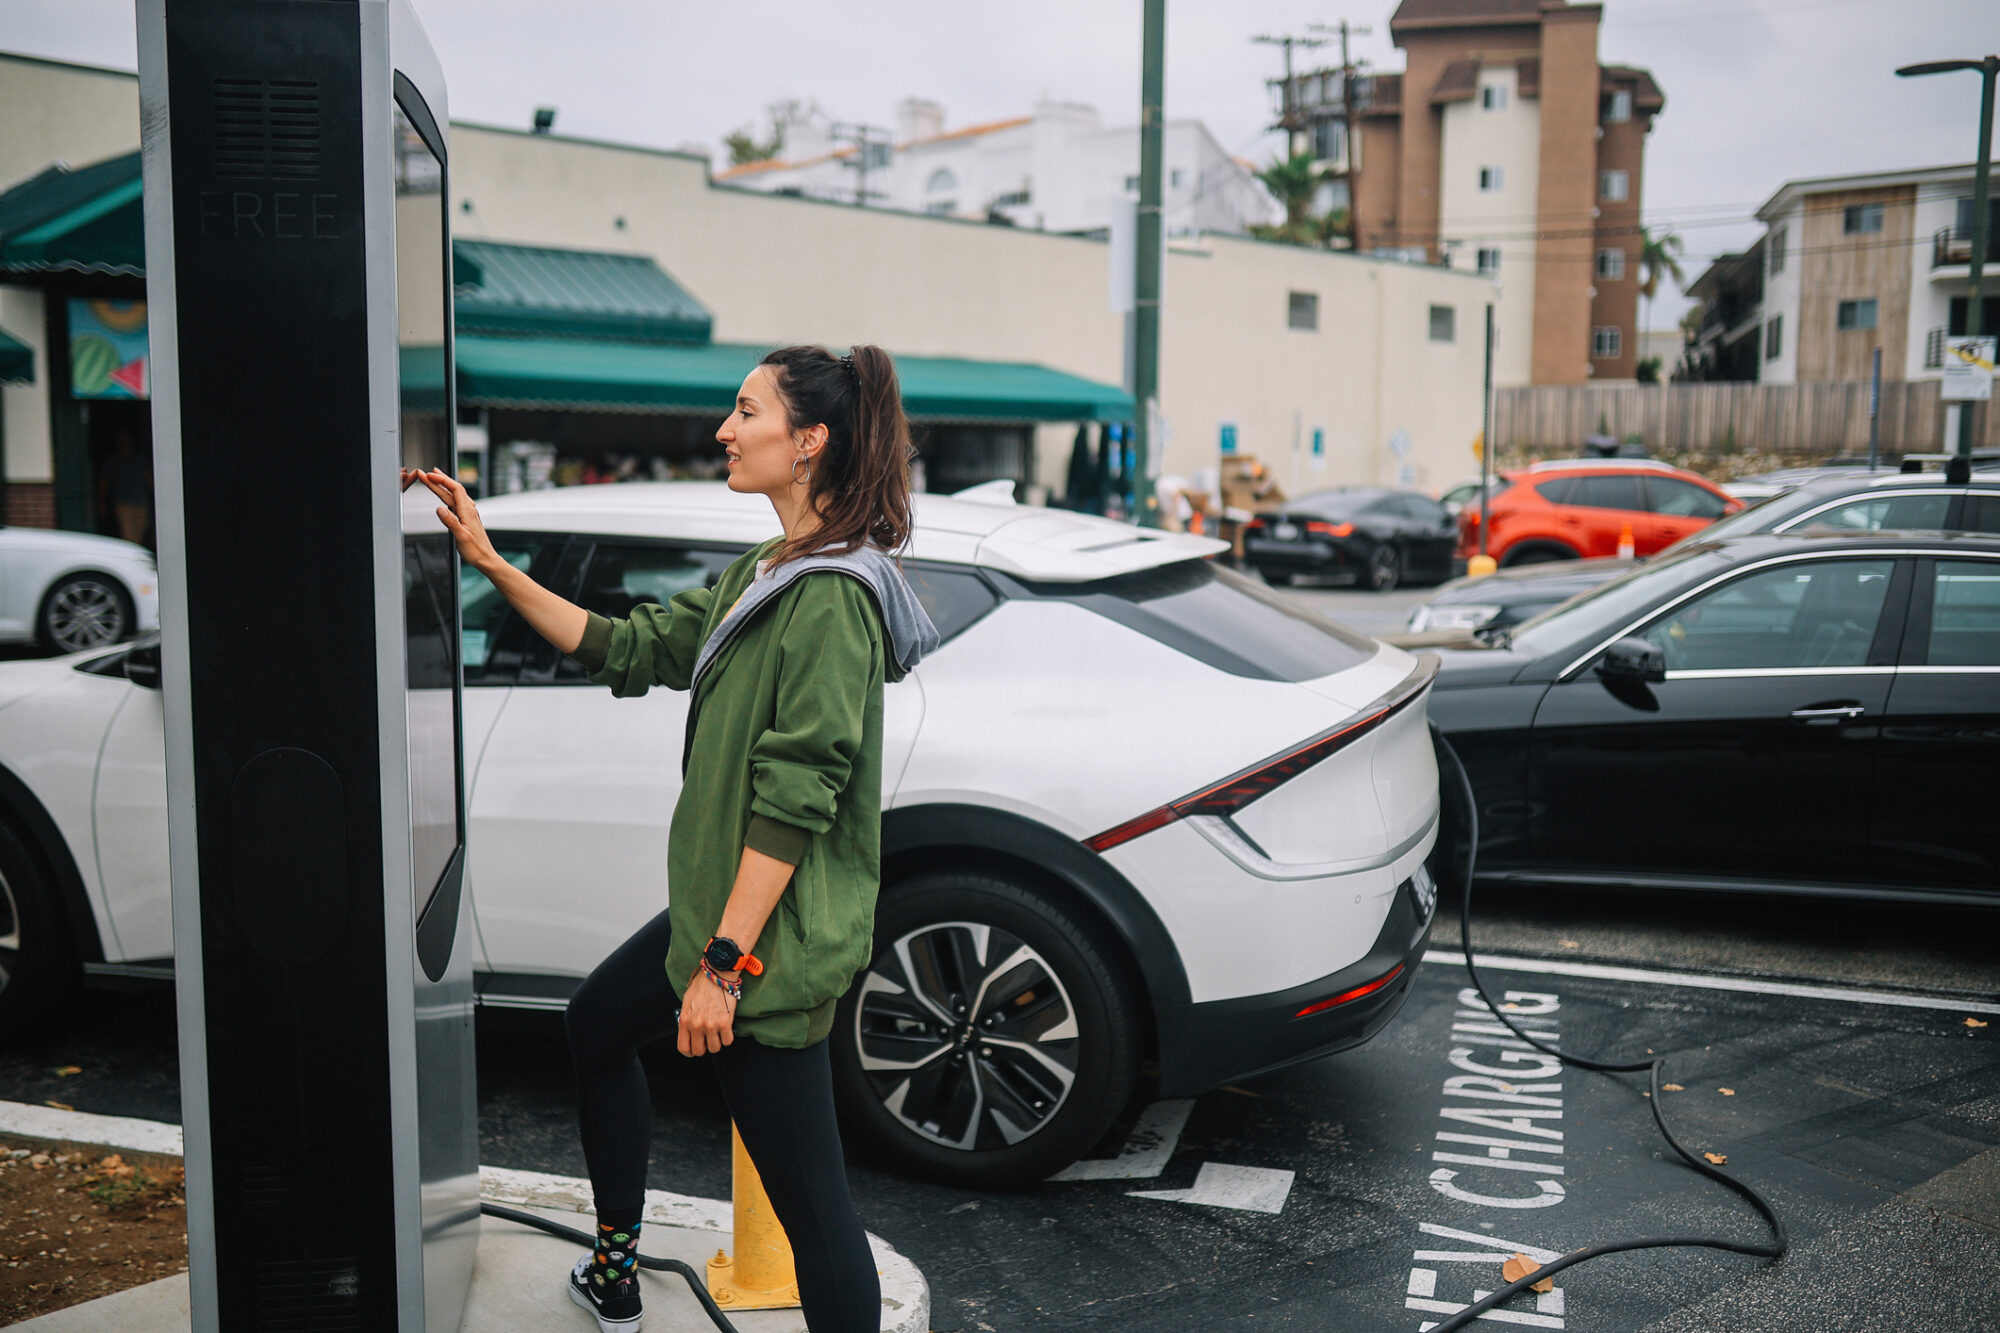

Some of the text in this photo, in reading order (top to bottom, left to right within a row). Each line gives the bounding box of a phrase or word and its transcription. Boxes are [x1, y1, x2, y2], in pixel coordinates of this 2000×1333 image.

[199, 191, 341, 239] FREE
[1405, 988, 1566, 1329] EV CHARGING
